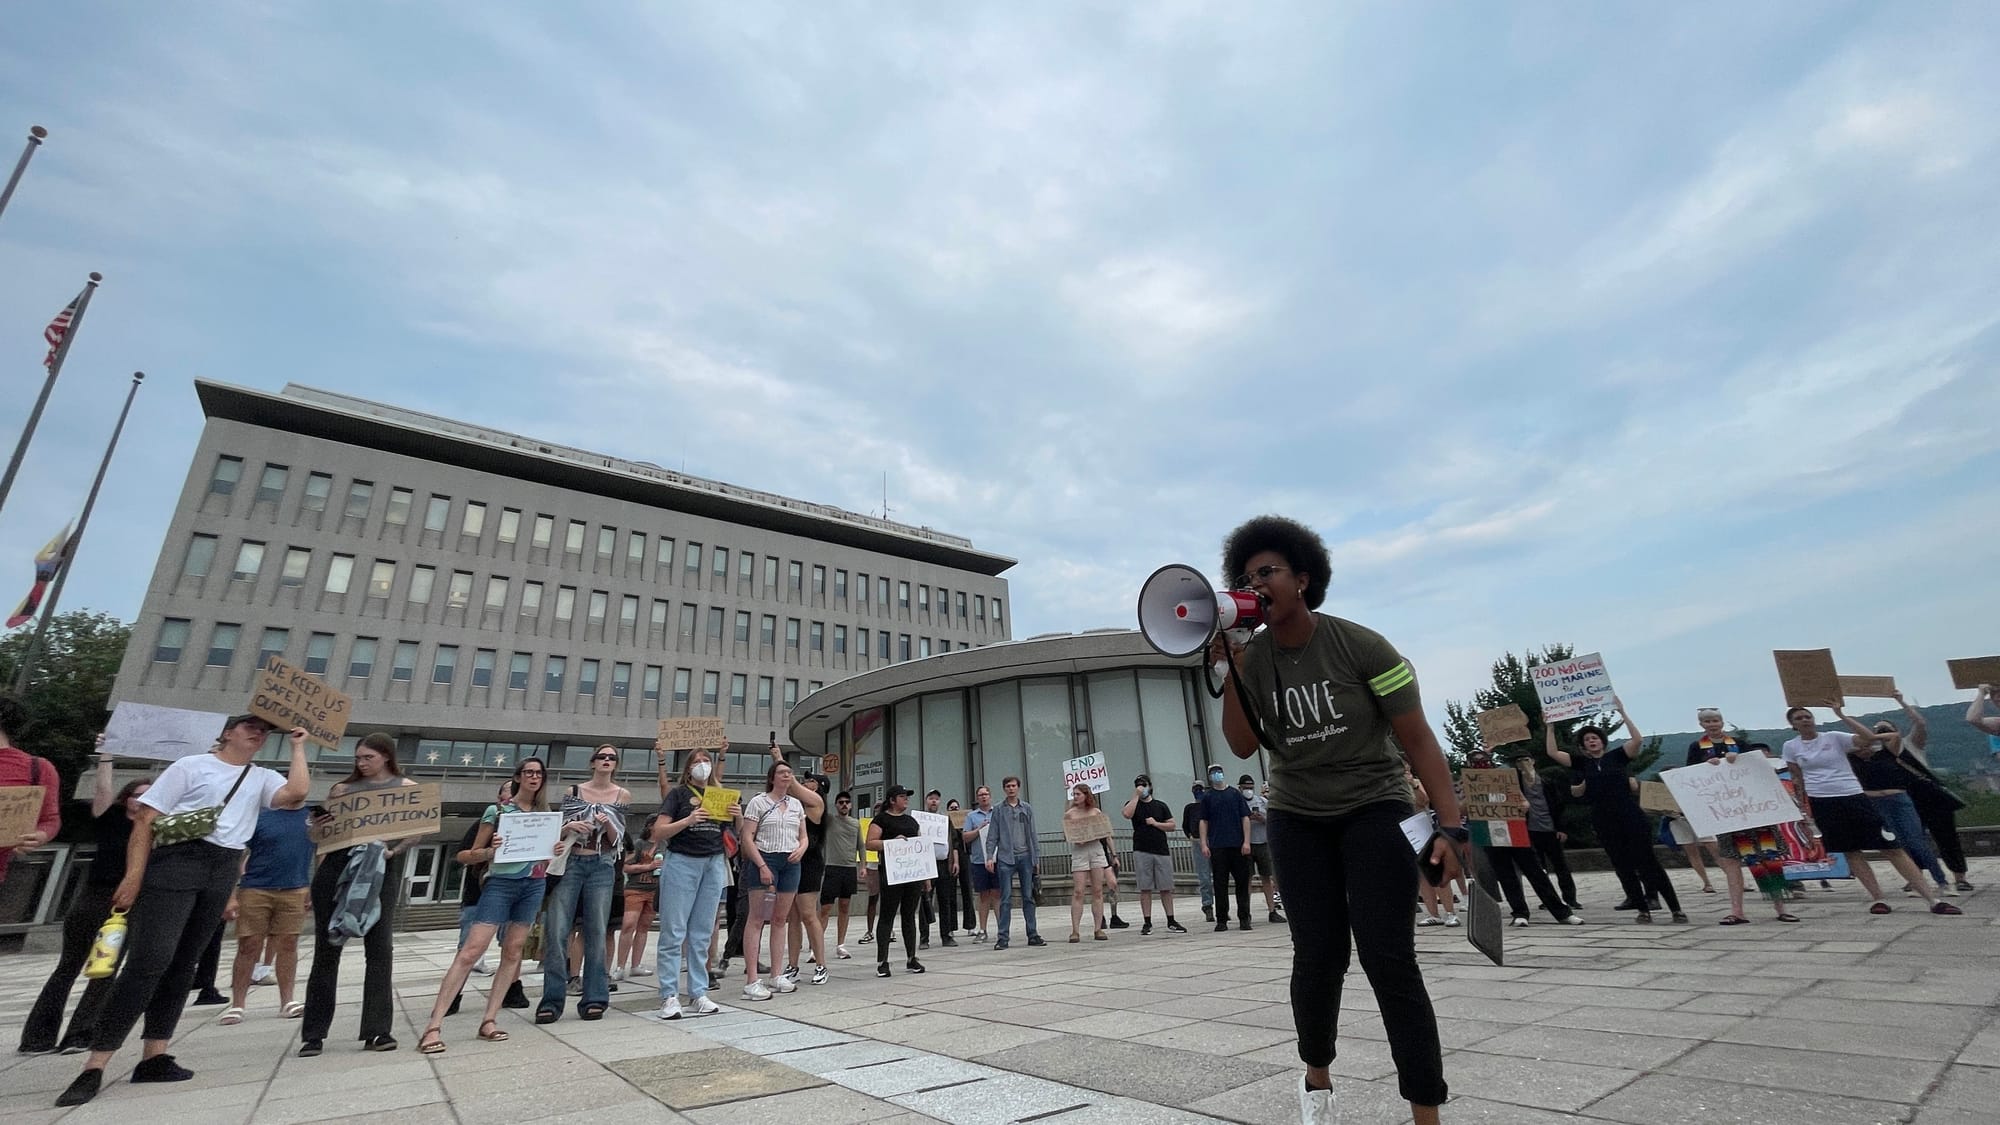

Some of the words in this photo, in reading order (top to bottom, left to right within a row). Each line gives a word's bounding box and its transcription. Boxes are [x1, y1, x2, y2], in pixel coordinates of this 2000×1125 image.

[1534, 667, 1556, 679] 200
[267, 659, 288, 679] WE
[290, 672, 321, 697] KEEP
[323, 694, 345, 713] US
[255, 694, 282, 711] OUT
[304, 700, 328, 721] ICE
[675, 720, 721, 730] SUPPORT
[659, 731, 679, 740] OUR
[1285, 733, 1307, 746] your
[1307, 723, 1349, 742] neighbor
[1070, 755, 1095, 771] END
[855, 769, 870, 777] TOWN
[871, 766, 883, 774] HALL
[1065, 766, 1107, 786] RACISM
[1465, 773, 1482, 782] WE
[1487, 773, 1517, 785] WILL
[1468, 783, 1490, 792] NOT
[328, 797, 370, 816] END
[376, 791, 422, 807] THE
[1468, 804, 1501, 818] FUCK
[1501, 804, 1526, 817] ICE
[321, 806, 439, 838] DEPORTATIONS
